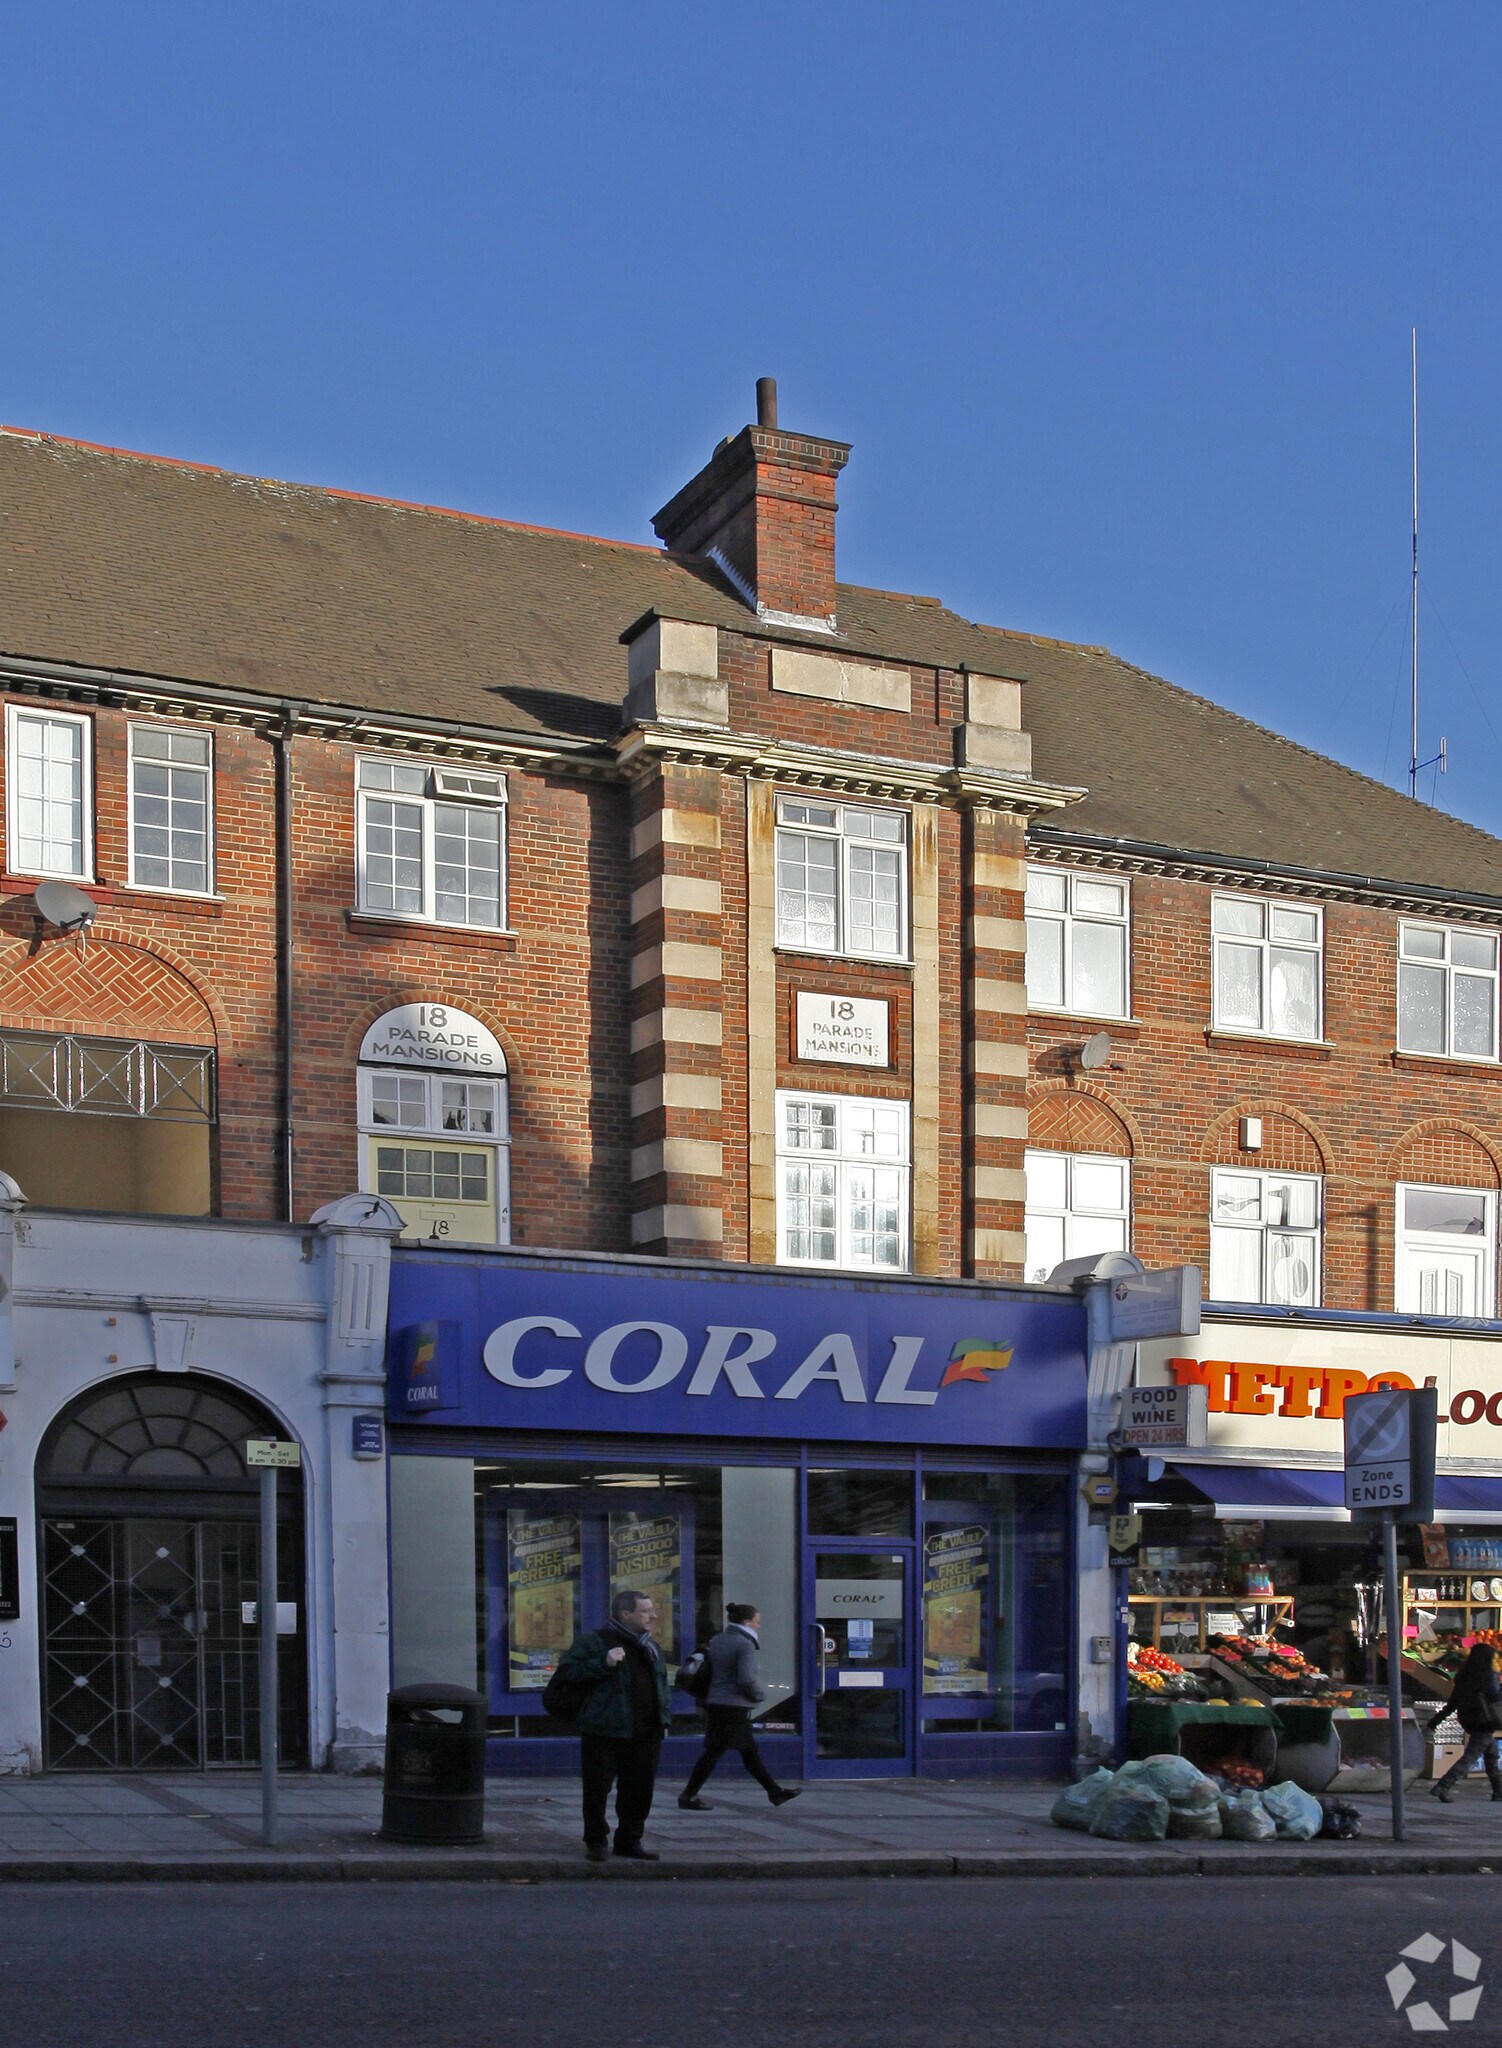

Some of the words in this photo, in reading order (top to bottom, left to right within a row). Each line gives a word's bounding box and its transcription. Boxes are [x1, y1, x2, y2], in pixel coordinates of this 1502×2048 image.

[419, 1005, 448, 1028] 18
[831, 1000, 855, 1021] 18
[389, 1027, 479, 1048] PARADE
[812, 1022, 873, 1040] PARADE
[372, 1042, 493, 1066] MANSIONS
[806, 1038, 881, 1058] MANSIONS
[432, 1219, 450, 1235] 18
[482, 1316, 941, 1405] CORAL
[407, 1385, 439, 1402] CORAL
[1131, 1389, 1177, 1404] FOOD
[1132, 1409, 1176, 1424] WINE
[1123, 1428, 1149, 1443] OPEN
[1151, 1428, 1163, 1443] 24
[1165, 1427, 1185, 1442] HRS
[1361, 1471, 1394, 1482] Zone
[1352, 1484, 1403, 1502] ENDS
[517, 1529, 535, 1541] THE
[619, 1530, 637, 1543] THE
[639, 1523, 671, 1539] VAULT
[931, 1538, 948, 1551] THE
[950, 1532, 980, 1547] VAULT
[617, 1537, 673, 1559] £250,000
[526, 1550, 562, 1568] FREE
[616, 1552, 671, 1577] INSIDE
[938, 1559, 971, 1578] FREE
[519, 1562, 569, 1584] CREDIT
[932, 1571, 977, 1593] CREDIT
[833, 1594, 879, 1603] CORAL
